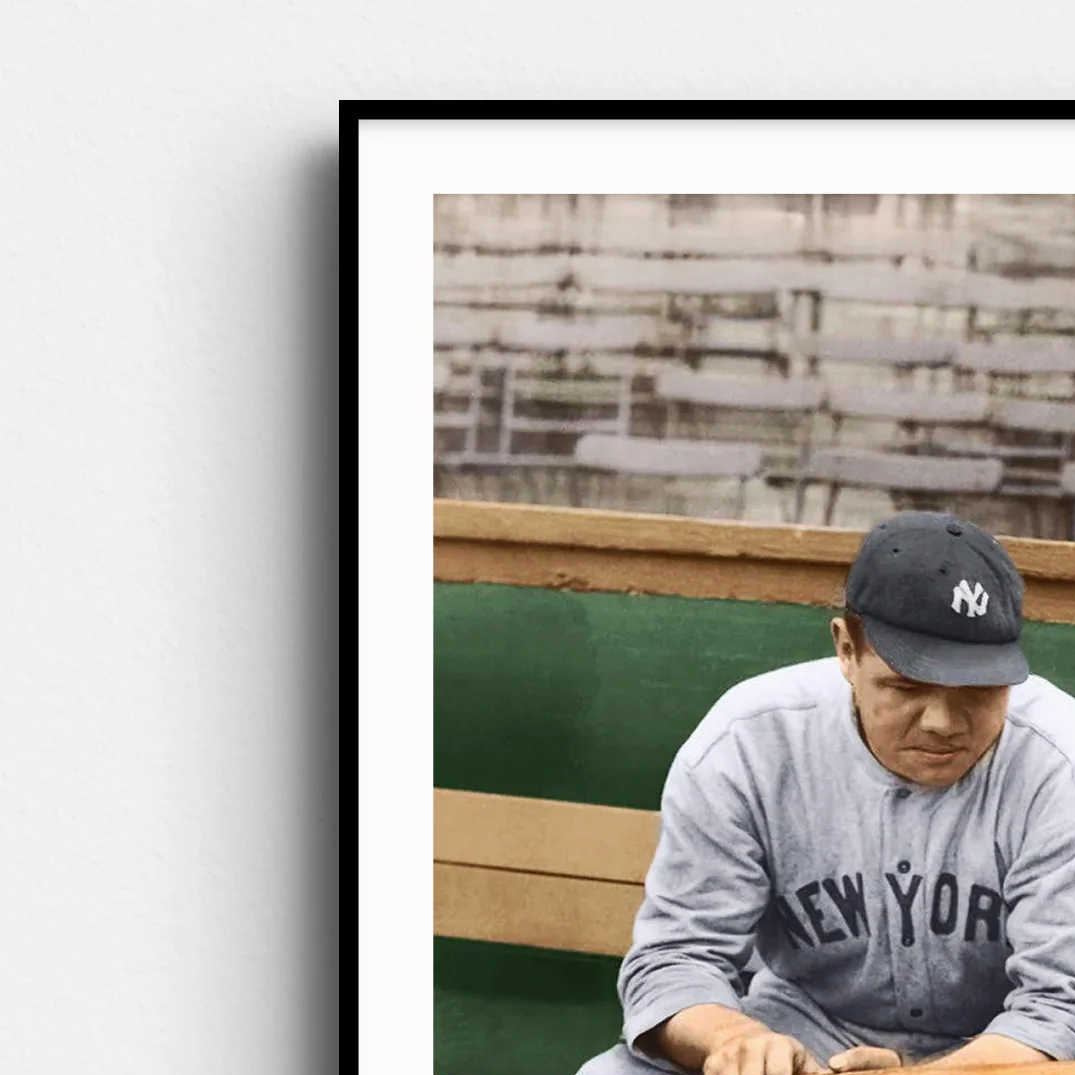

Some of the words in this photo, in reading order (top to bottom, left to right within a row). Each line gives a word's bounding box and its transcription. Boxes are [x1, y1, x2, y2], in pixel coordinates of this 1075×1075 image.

[951, 579, 990, 618] NY
[774, 871, 871, 949] NEW
[885, 872, 1004, 948] YOR
